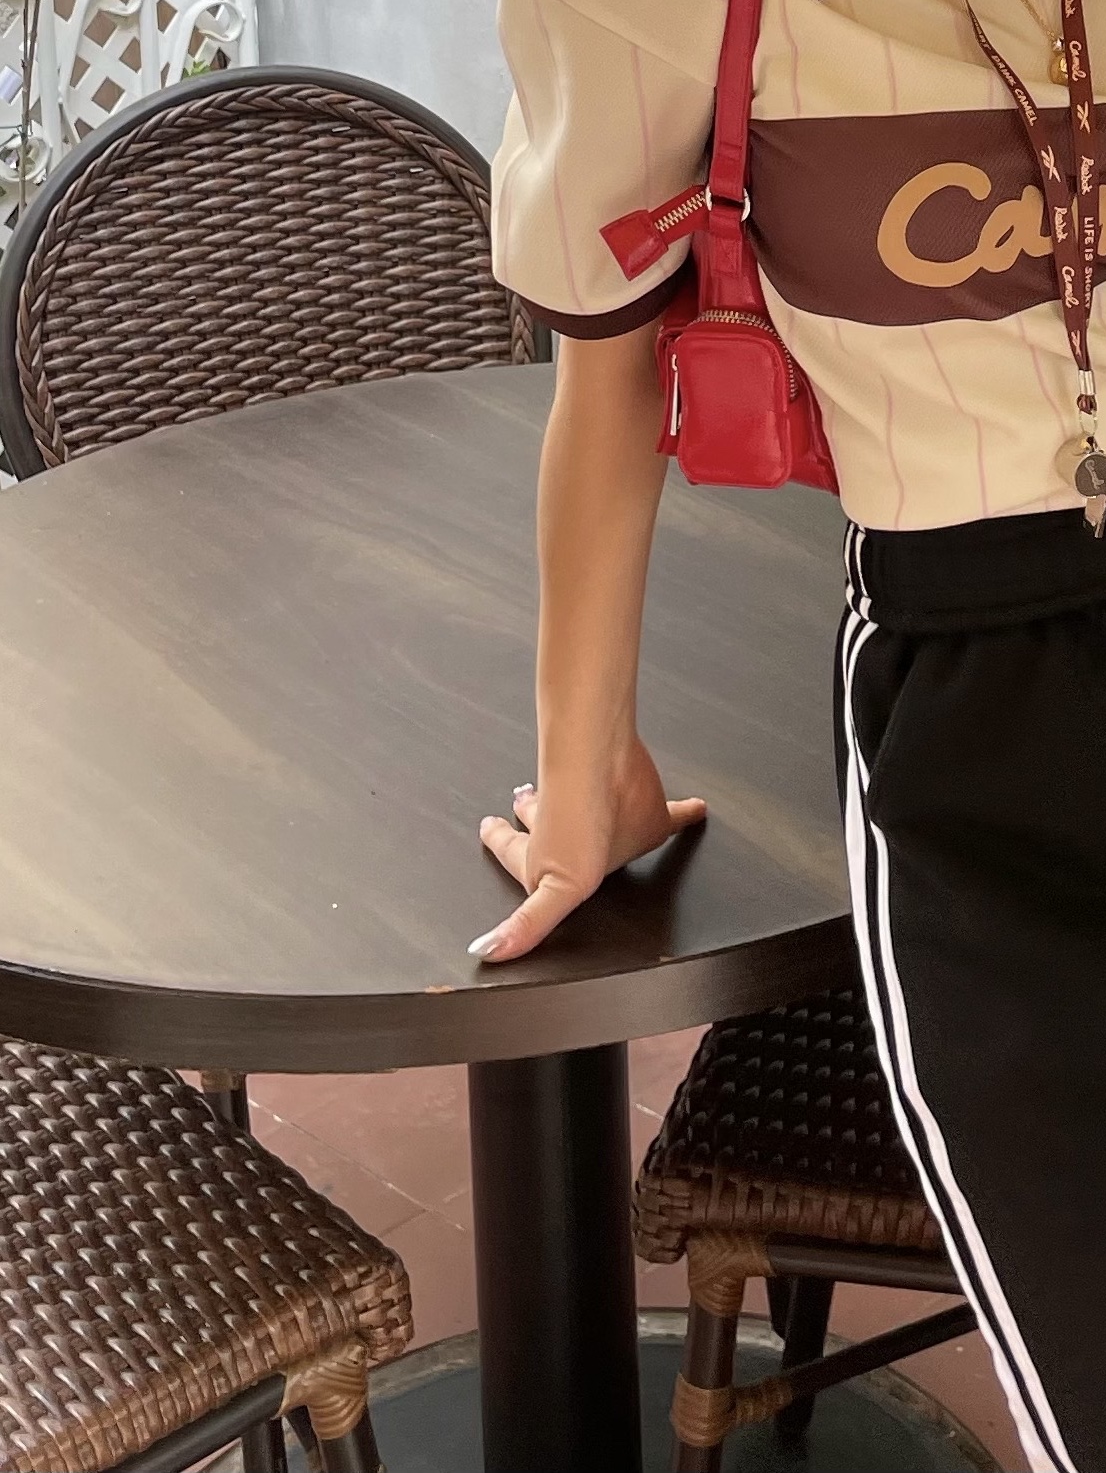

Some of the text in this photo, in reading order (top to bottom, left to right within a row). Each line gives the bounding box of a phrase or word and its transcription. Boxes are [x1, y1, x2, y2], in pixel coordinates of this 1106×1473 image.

[1069, 40, 1087, 82] Camel
[1014, 87, 1038, 126] CAMEL
[1080, 155, 1095, 196] Reebok
[1084, 216, 1095, 245] LIFE
[1054, 206, 1080, 308] Reebok Camel
[1084, 248, 1094, 262] IS
